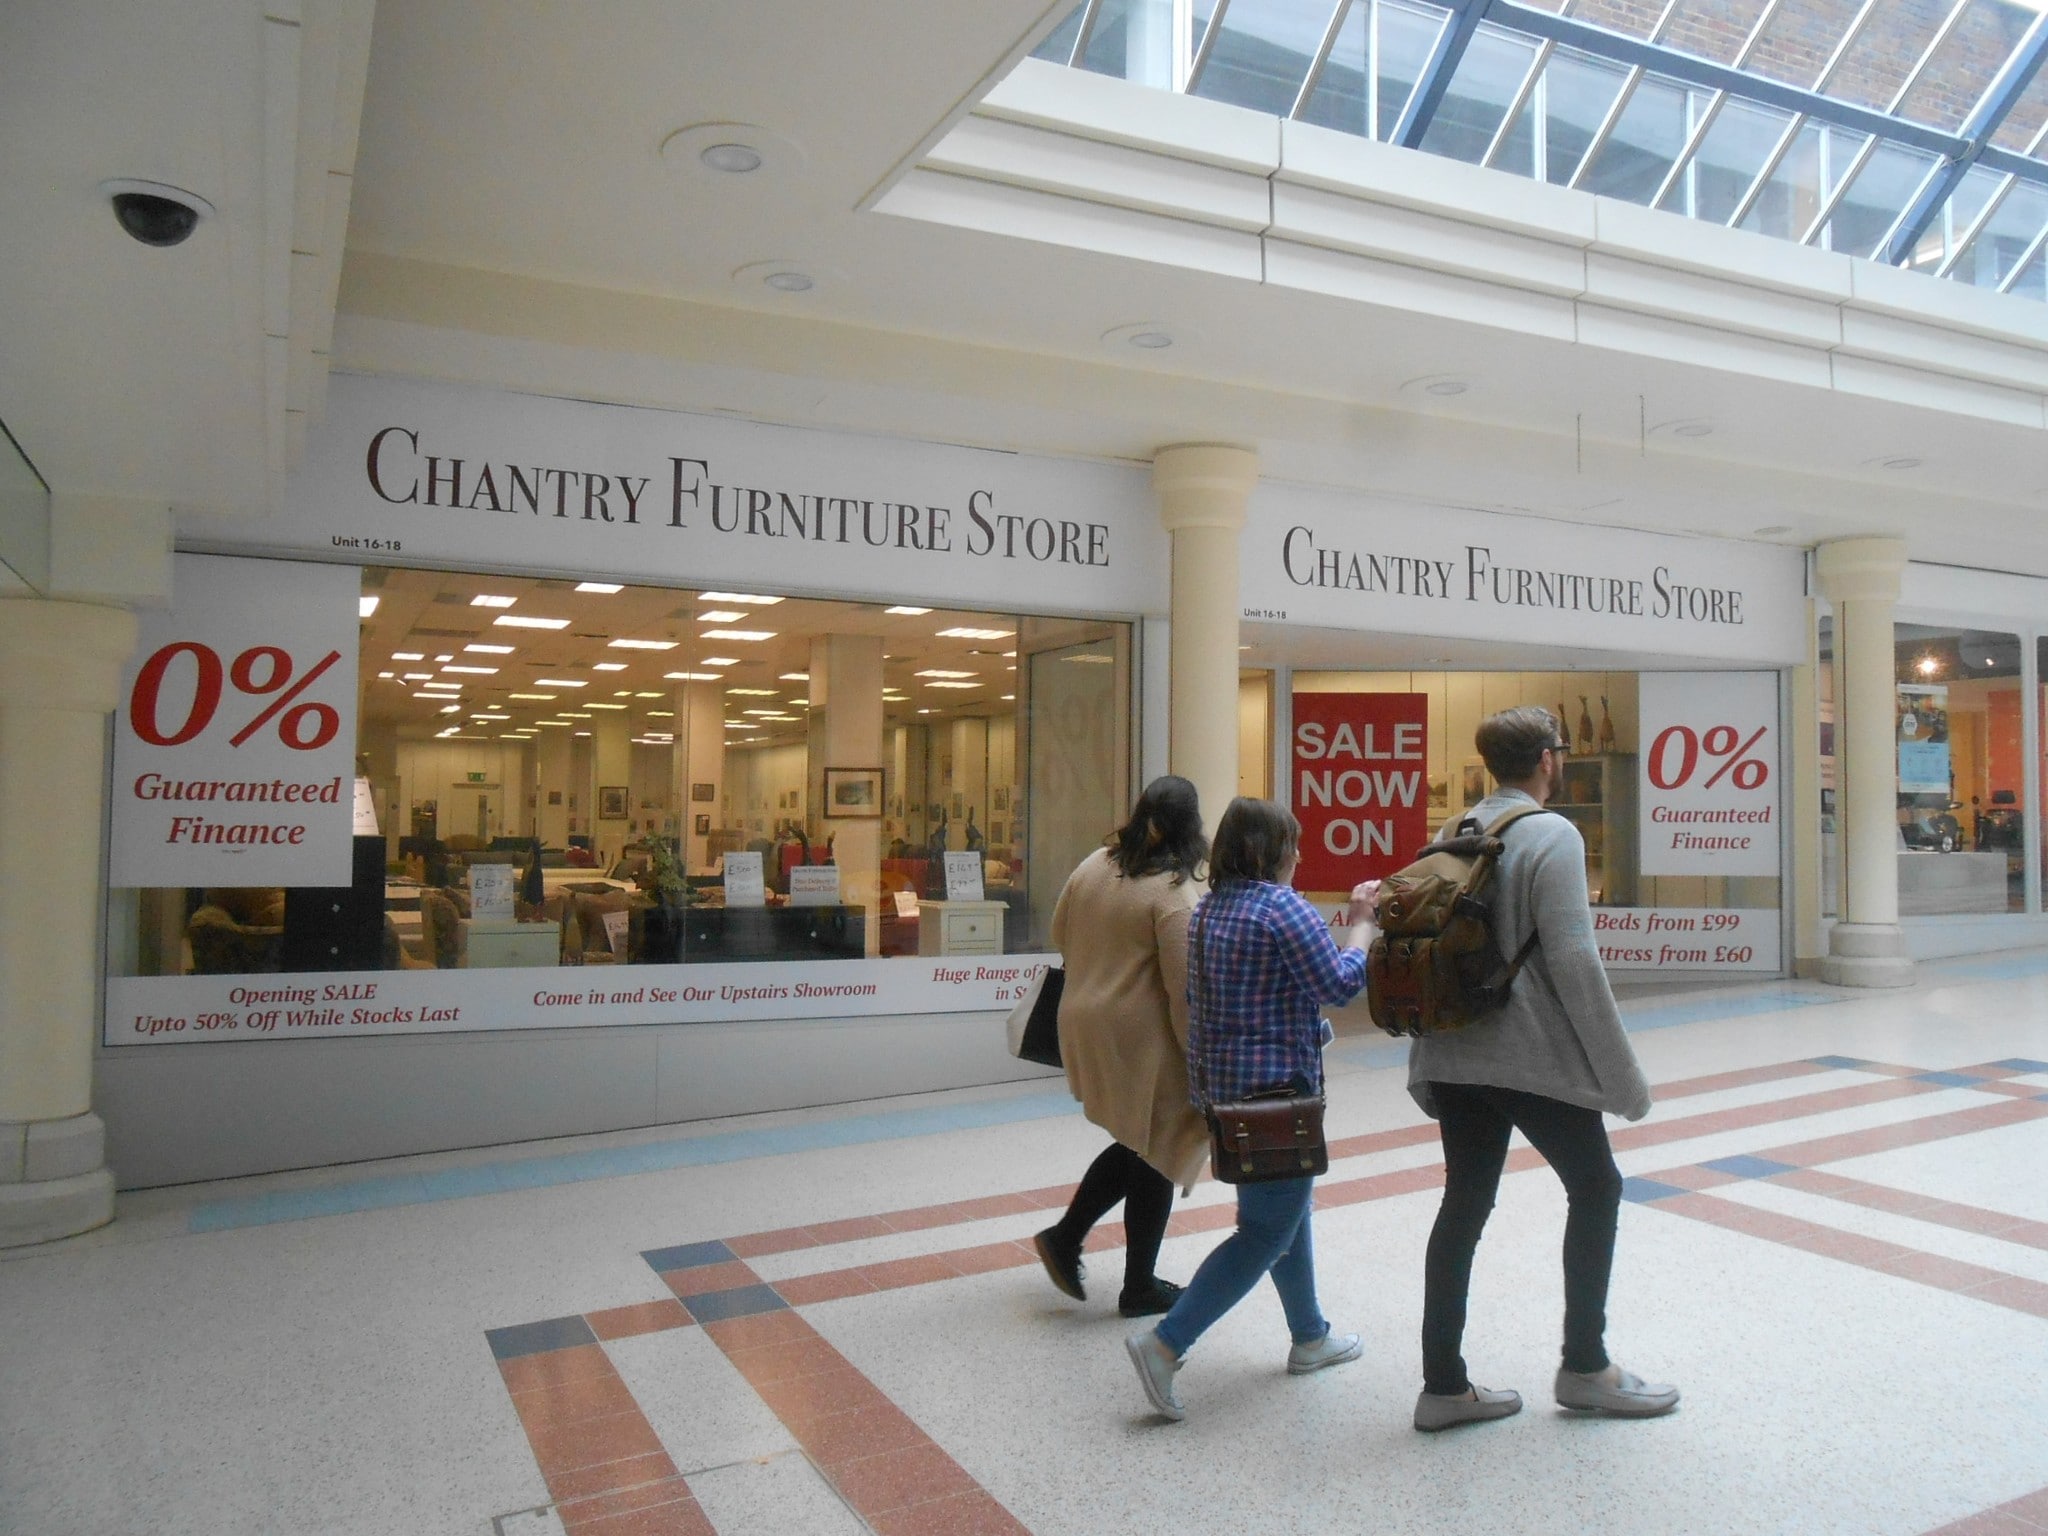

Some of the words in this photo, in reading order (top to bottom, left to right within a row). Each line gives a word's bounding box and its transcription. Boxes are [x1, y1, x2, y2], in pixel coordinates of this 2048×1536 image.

[366, 426, 651, 524] CHANTRY
[666, 456, 952, 553] FURNITURE
[966, 489, 1111, 568] STORE
[332, 535, 360, 548] Unit
[363, 538, 402, 551] 16-18
[1282, 525, 1455, 599] CHANTRY
[1464, 545, 1644, 616] FURNITURE
[1652, 566, 1744, 625] STORE
[1243, 607, 1262, 618] Unit
[1263, 609, 1287, 620] 16-18
[129, 641, 342, 751] 0%
[1296, 722, 1423, 760] SALE
[1647, 725, 1769, 790] 0%
[134, 773, 342, 804] Guaranteed
[1301, 769, 1421, 808] NOW
[1651, 805, 1771, 824] Guaranteed
[166, 816, 306, 845] Finance
[1324, 818, 1393, 856] ON
[1671, 831, 1751, 850] Finance
[1593, 912, 1641, 932] Beds
[1646, 913, 1695, 935] from
[1701, 913, 1741, 932] £99
[1599, 945, 1653, 962] ttress
[1658, 944, 1707, 966] from
[1714, 945, 1753, 963] £60
[932, 967, 971, 985] Huge
[974, 966, 1020, 983] Range
[1022, 963, 1041, 982] of
[229, 985, 318, 1008] Opening
[322, 984, 378, 1001] SALE
[533, 990, 584, 1007] Come
[588, 988, 606, 1005] in
[610, 986, 645, 1004] and
[649, 986, 678, 1003] See
[682, 985, 716, 1002] Our
[720, 983, 789, 1004] Upstairs
[793, 982, 878, 998] Showroom
[995, 985, 1009, 1000] in
[134, 1014, 187, 1037] Upto
[193, 1012, 239, 1031] 50%
[246, 1010, 281, 1031] Off
[285, 1007, 345, 1027] While
[350, 1006, 414, 1025] Stocks
[418, 1005, 462, 1022] Last
